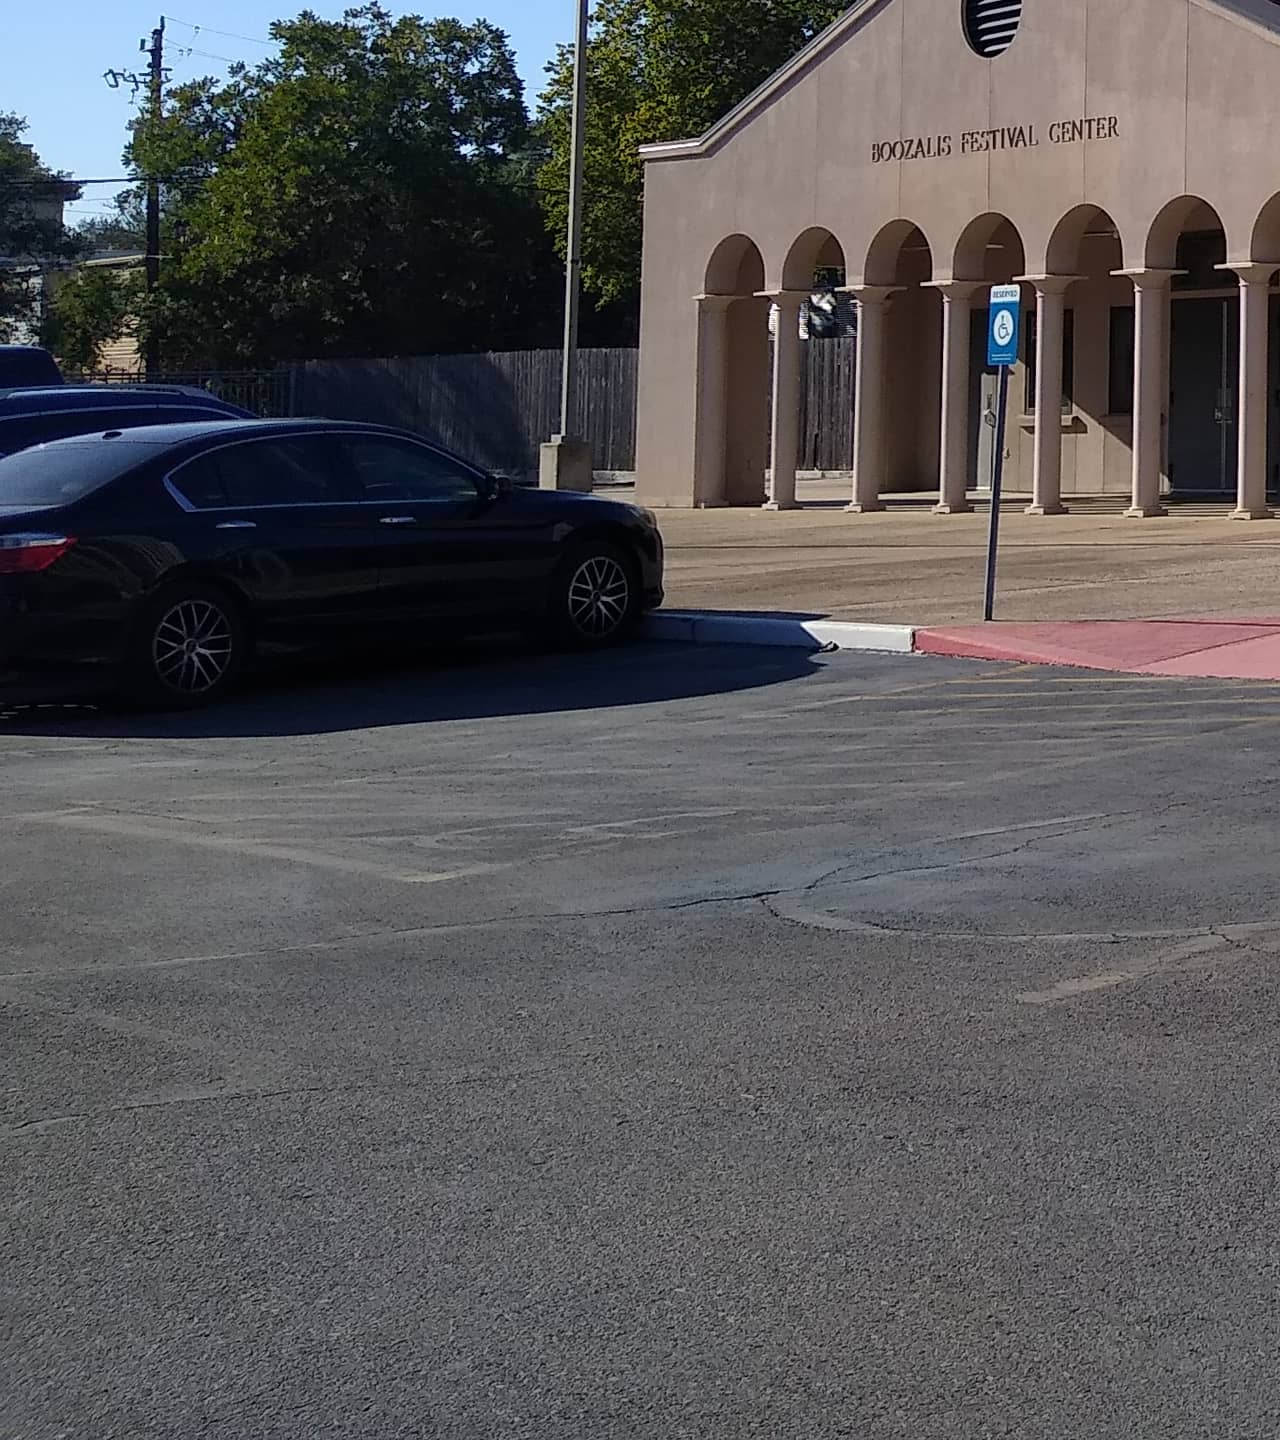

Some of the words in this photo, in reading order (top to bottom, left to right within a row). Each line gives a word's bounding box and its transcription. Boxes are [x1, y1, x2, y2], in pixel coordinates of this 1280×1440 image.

[871, 135, 951, 163] BOOZALIS
[961, 125, 1038, 153] FESTIVAL
[1049, 116, 1119, 143] CENTER
